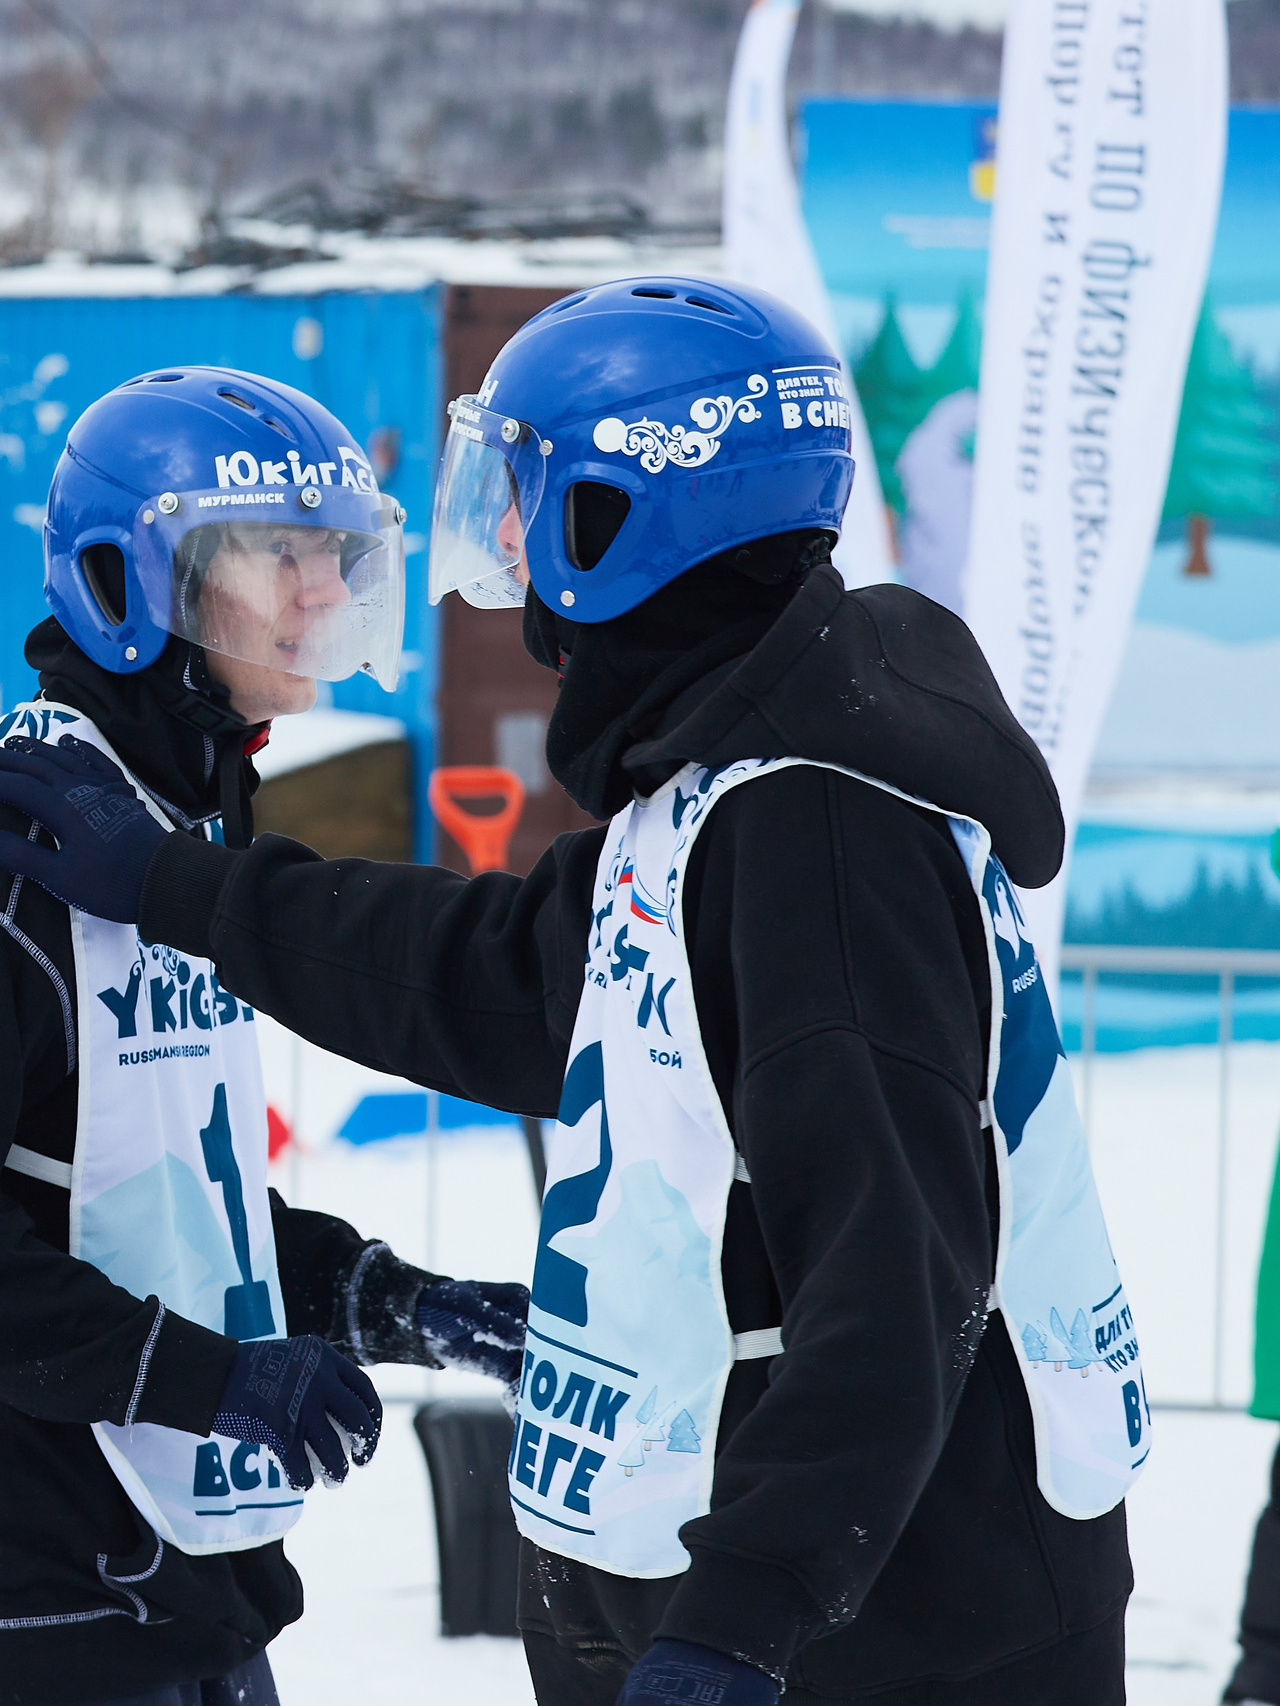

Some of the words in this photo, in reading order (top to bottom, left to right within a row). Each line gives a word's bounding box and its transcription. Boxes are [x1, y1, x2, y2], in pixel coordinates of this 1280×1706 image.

[776, 377, 801, 391] ДЛЯ
[778, 389, 799, 400] КТО
[780, 402, 803, 430] В
[806, 400, 850, 430] СНЕ
[197, 493, 286, 508] МУРМАНСК
